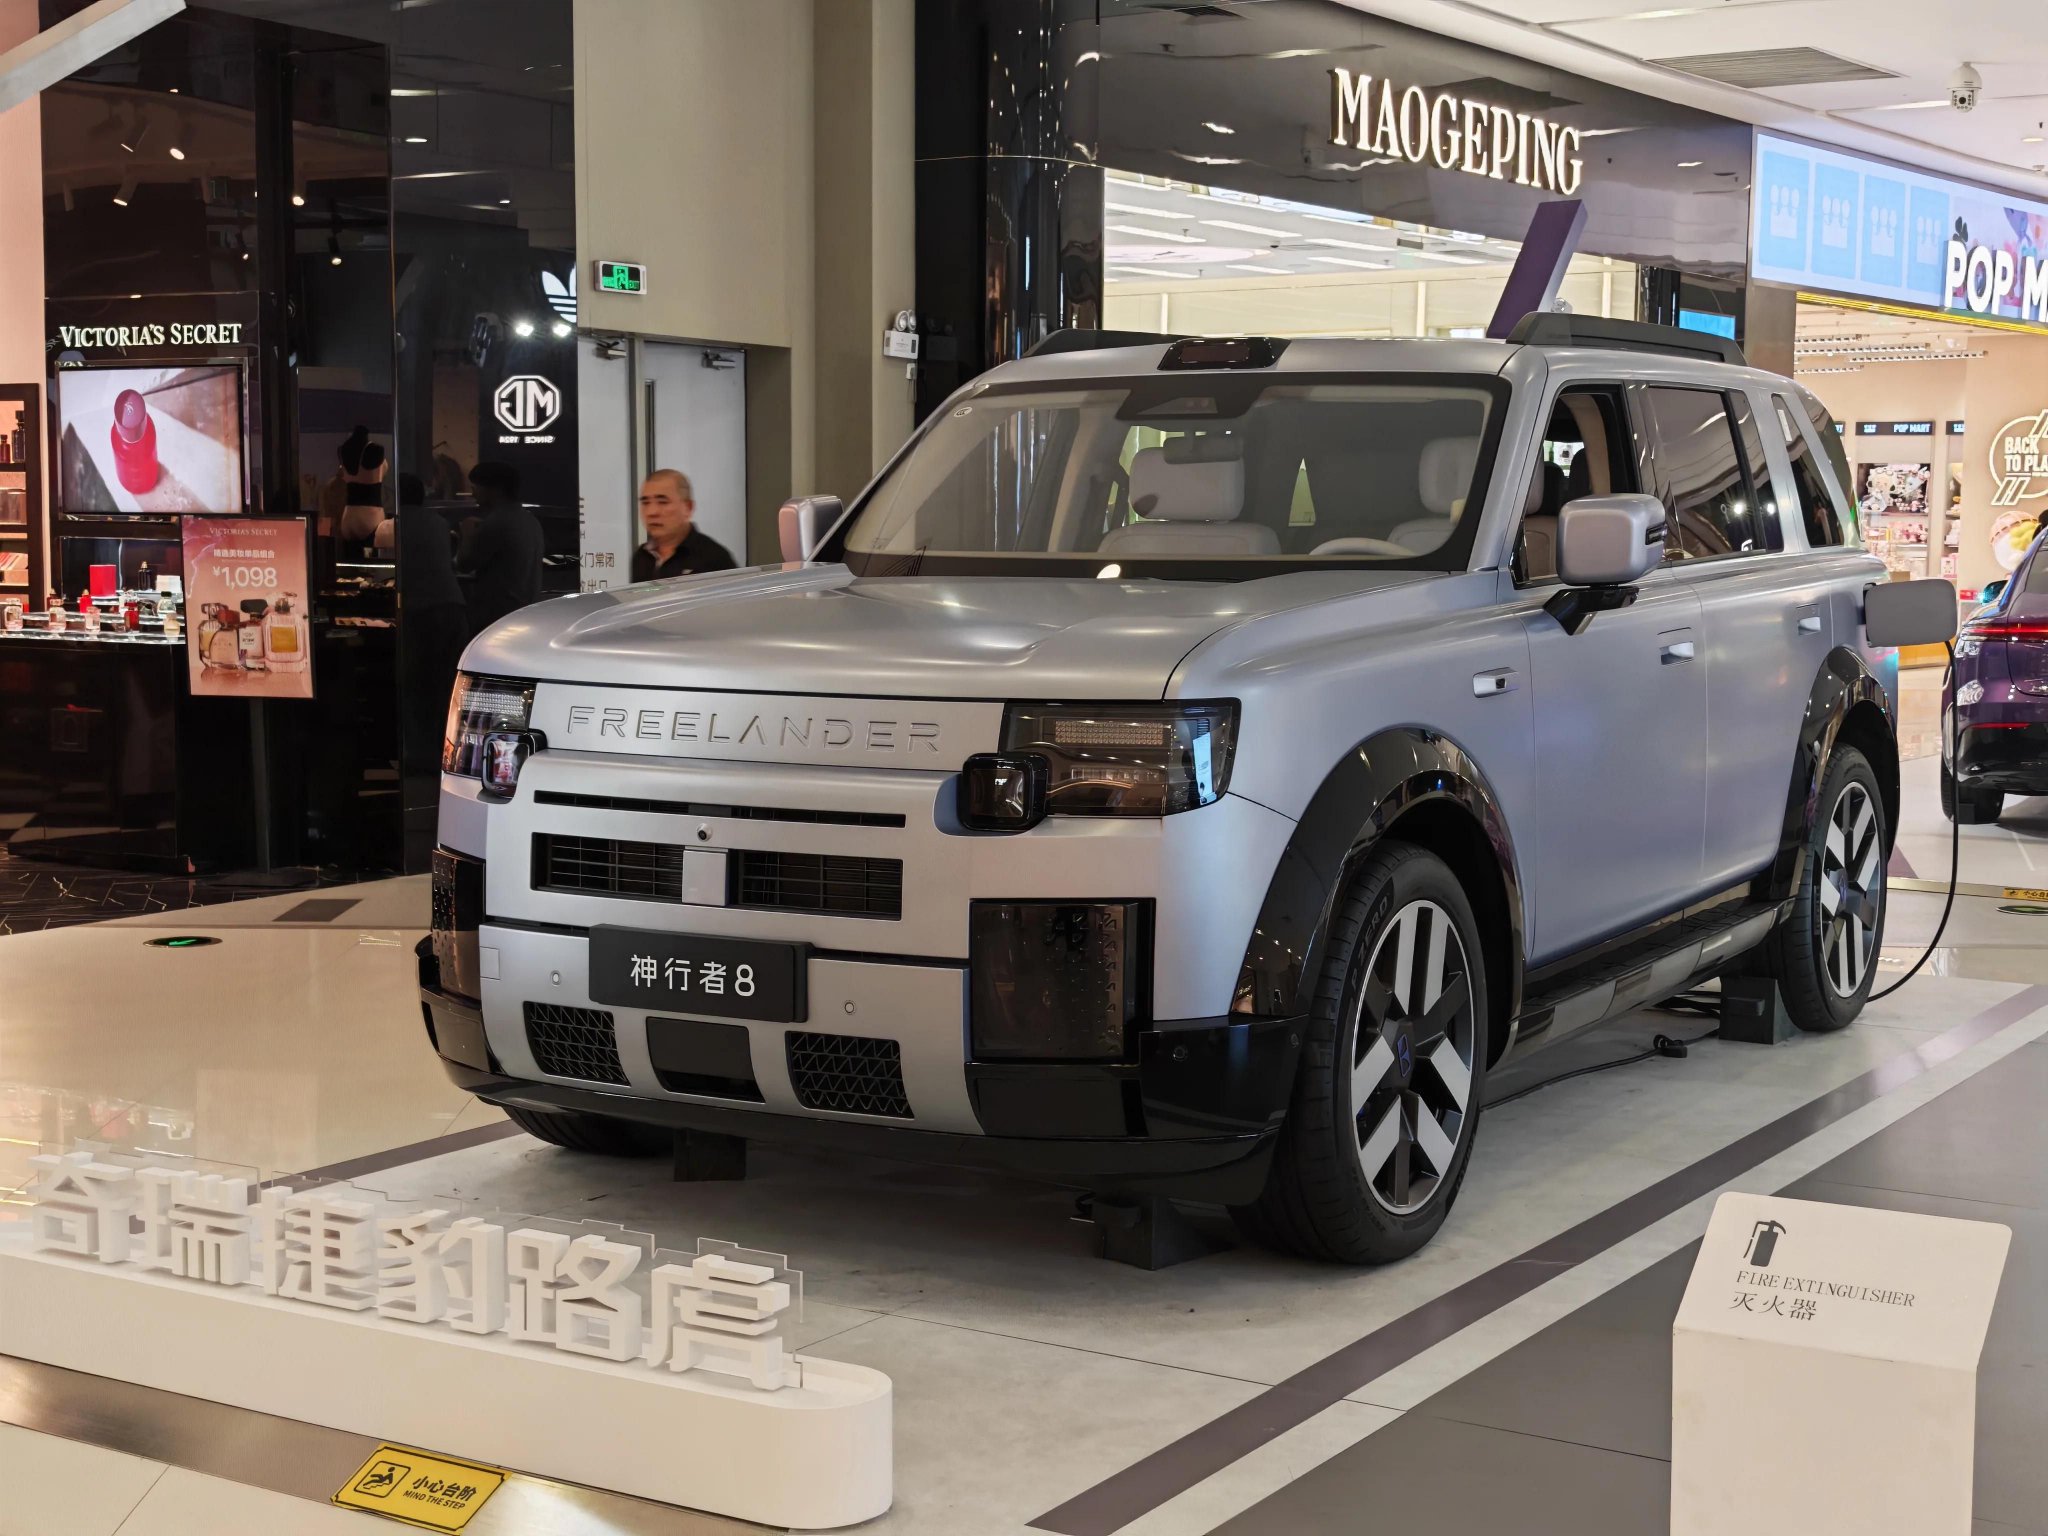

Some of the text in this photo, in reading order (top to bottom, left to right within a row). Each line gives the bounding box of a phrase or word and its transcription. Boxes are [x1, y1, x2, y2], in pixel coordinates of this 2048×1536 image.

[1331, 67, 1584, 196] MAOGEPING
[1943, 239, 2048, 323] POP M
[58, 323, 242, 348] VICTORIA'S SECRET
[2004, 436, 2040, 454] BACK
[2004, 454, 2021, 472] TO
[566, 704, 940, 753] FREELANDER
[630, 953, 756, 998] 神行者8
[26, 1150, 793, 1391] 奇瑞捷豹路虎
[1728, 1290, 1817, 1322] 灭火器
[1736, 1270, 1916, 1308] FIRE EXTINGUISHER
[402, 1490, 466, 1510] MIND THE STEP
[412, 1476, 476, 1501] 小心台阶
